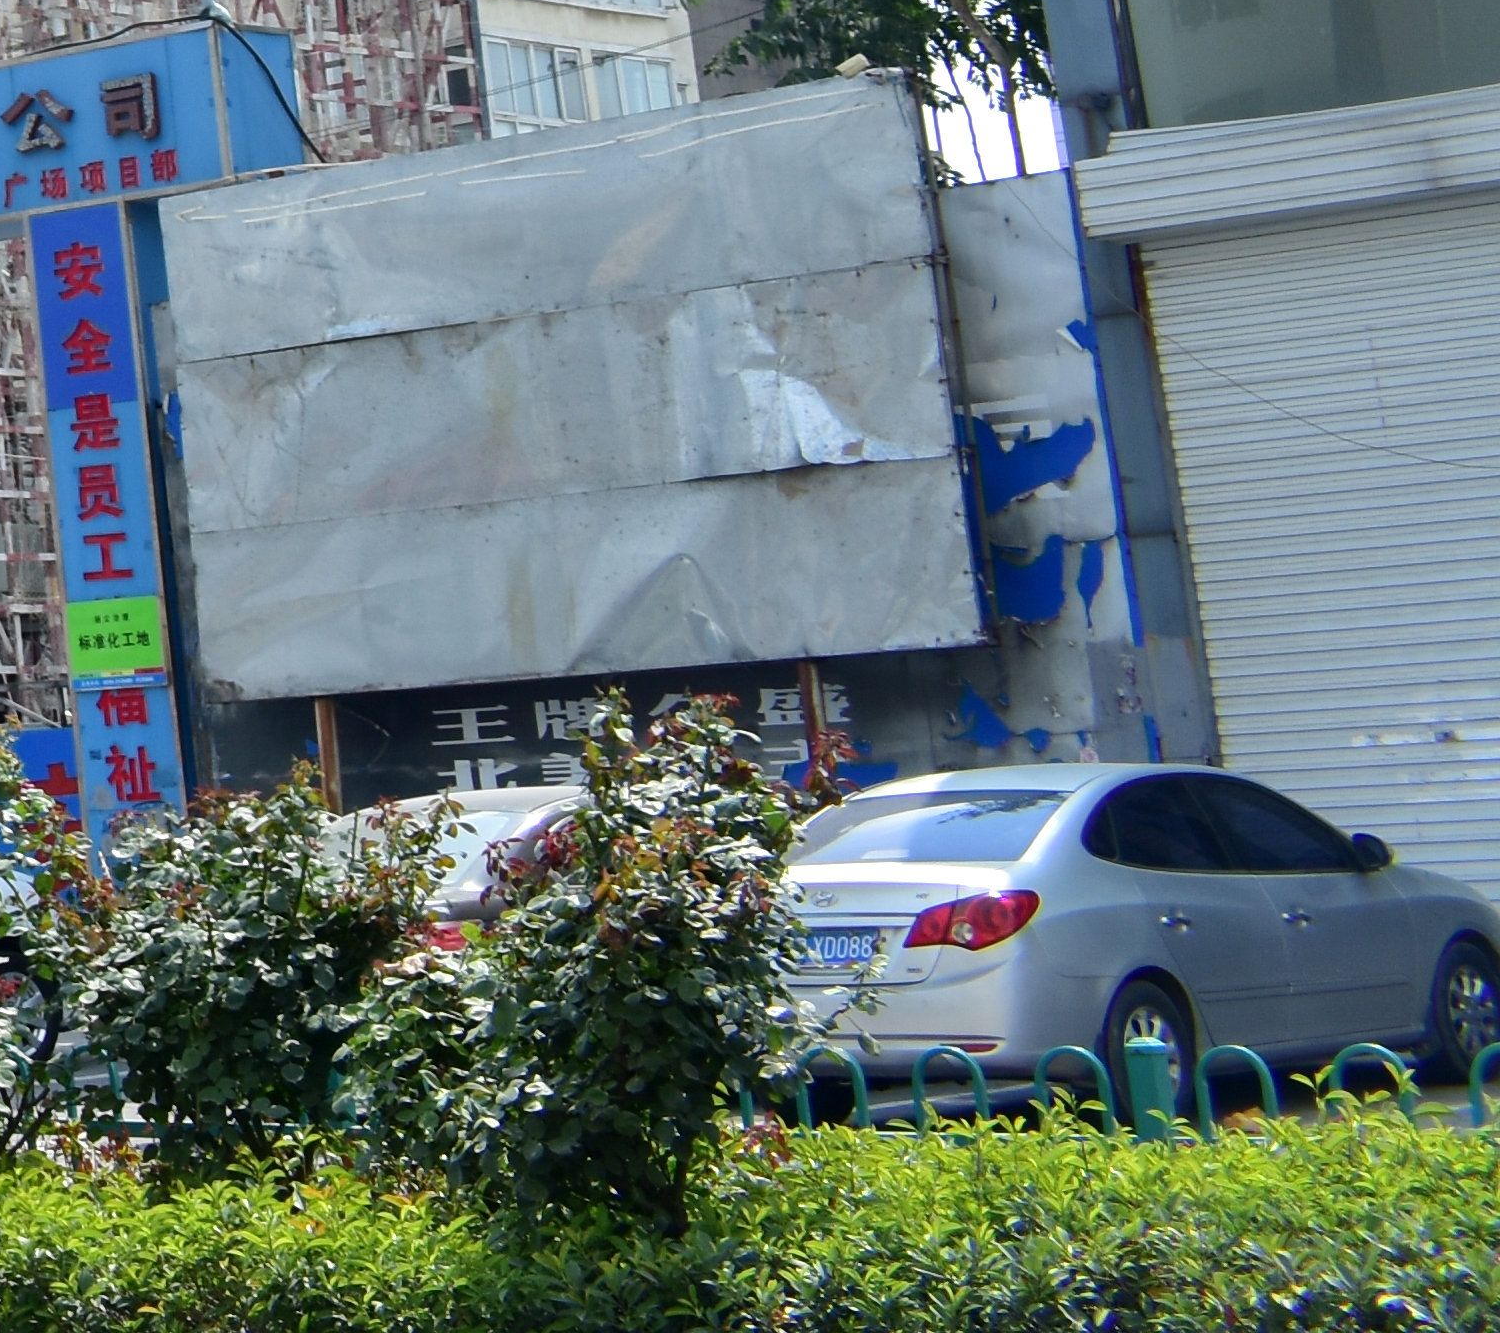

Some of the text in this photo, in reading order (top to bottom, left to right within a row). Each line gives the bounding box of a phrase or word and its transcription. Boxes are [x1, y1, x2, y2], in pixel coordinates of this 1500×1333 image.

[52, 241, 163, 803] 安全是员工福祉
[79, 630, 150, 650] 标准化工地
